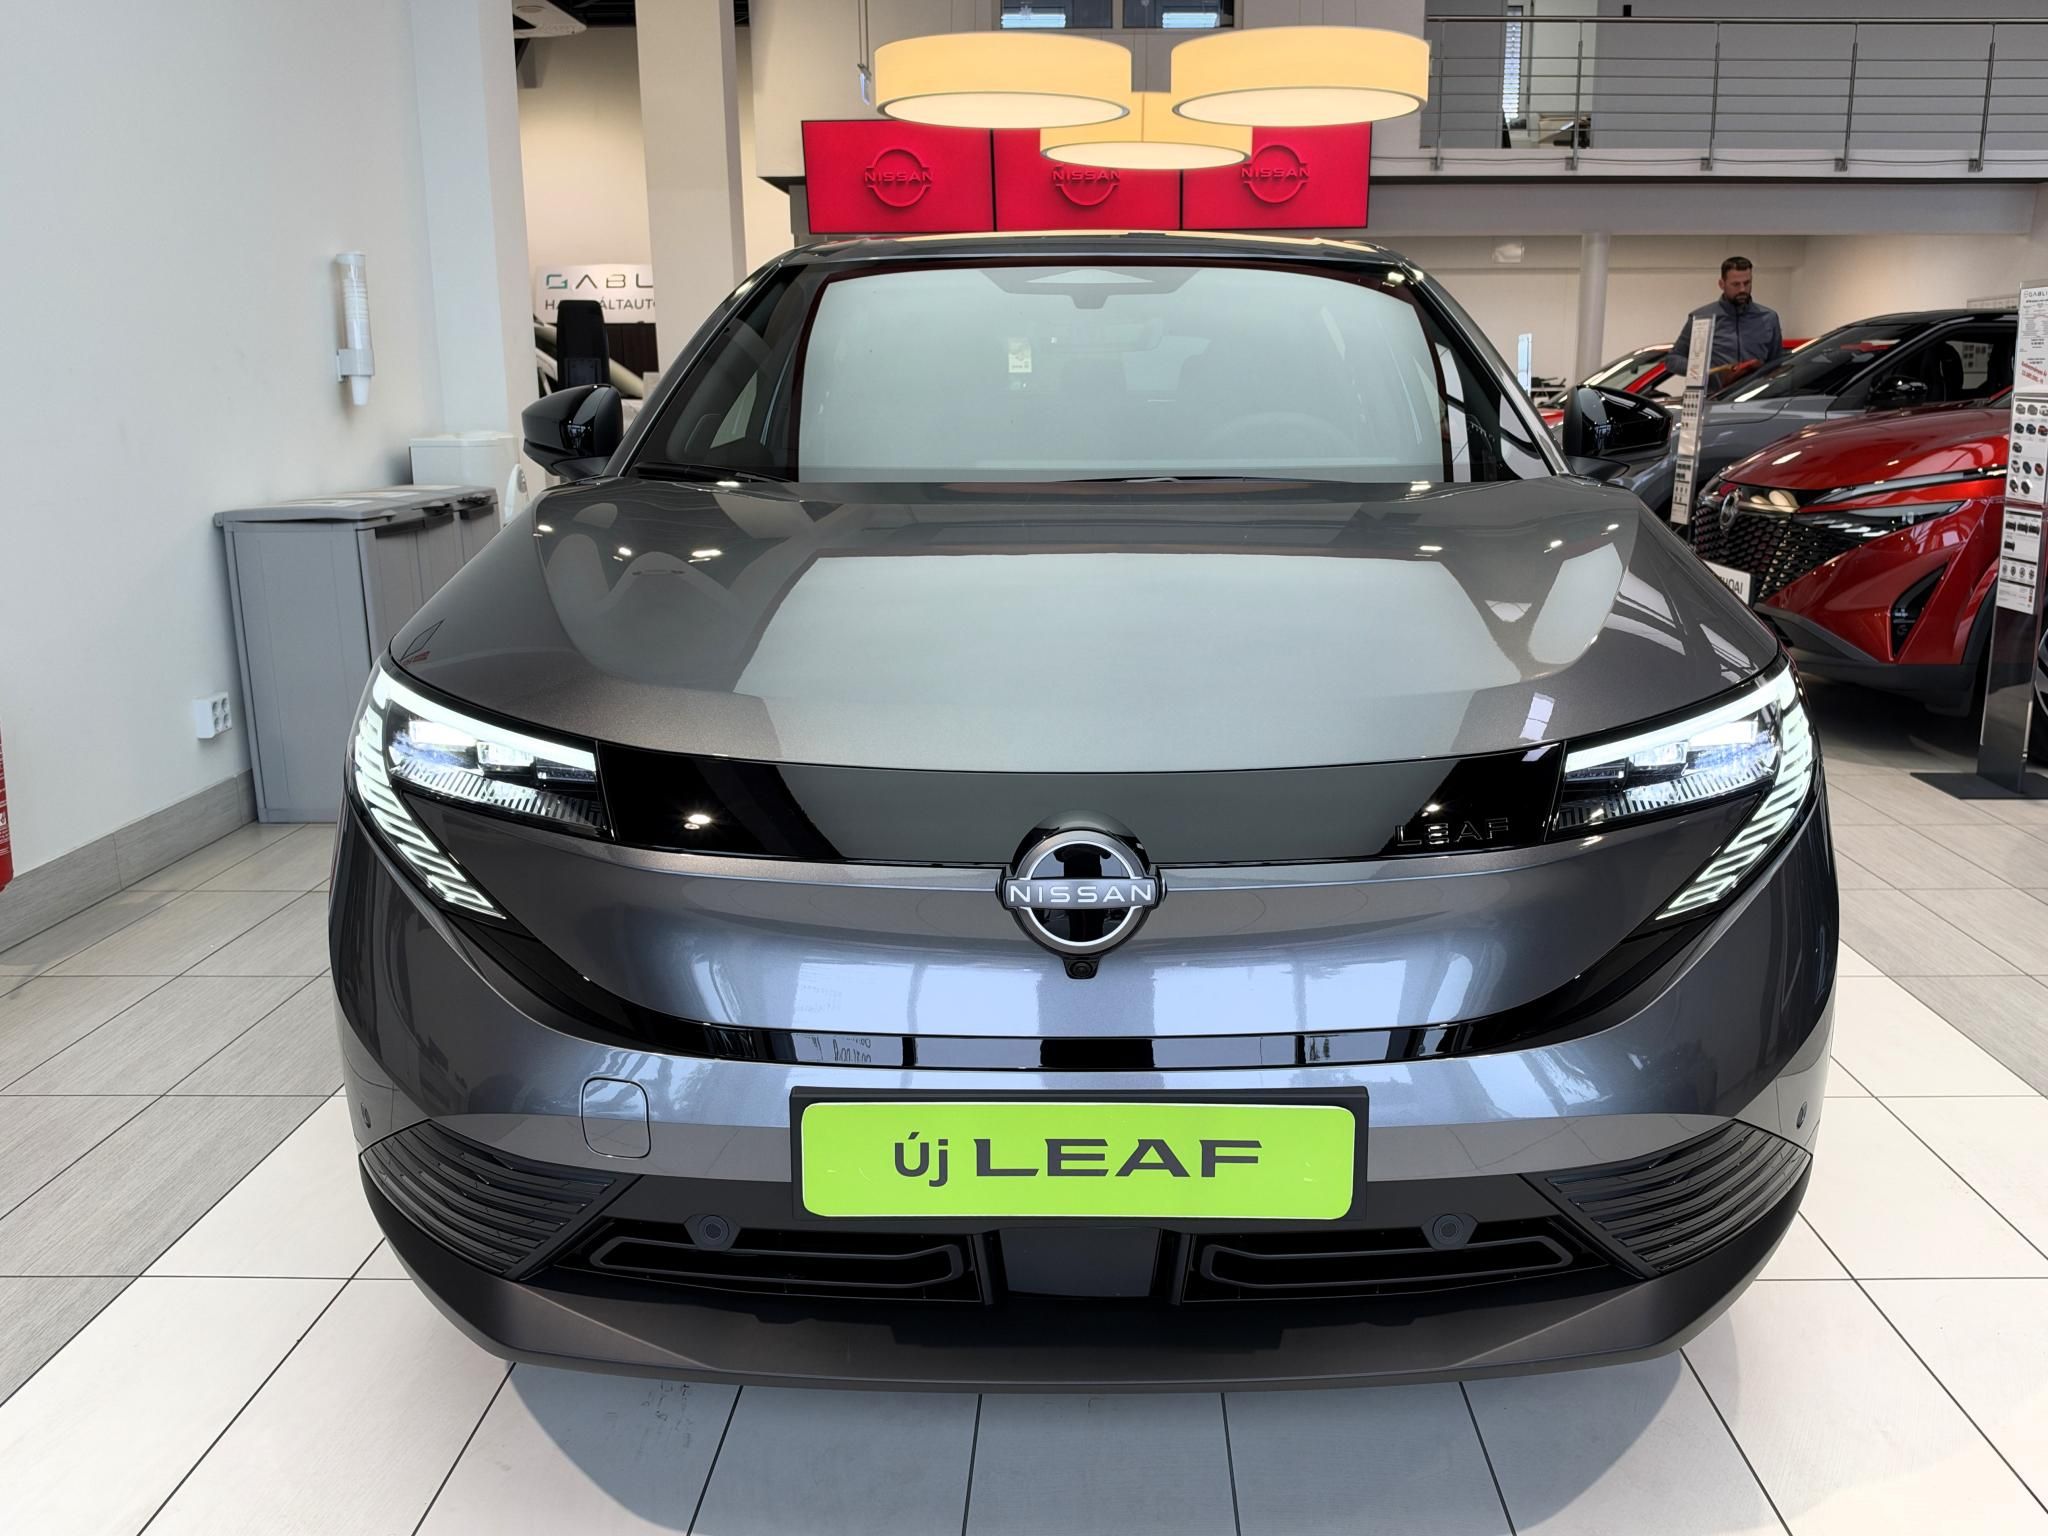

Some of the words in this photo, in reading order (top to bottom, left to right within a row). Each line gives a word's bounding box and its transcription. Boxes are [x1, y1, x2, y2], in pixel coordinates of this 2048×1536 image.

[864, 171, 934, 183] NISSAN
[1052, 170, 1120, 181] NISSAN
[1241, 167, 1313, 178] NISSAN
[1395, 817, 1509, 847] LEAF
[1010, 885, 1152, 903] NISSAN
[894, 1132, 949, 1187] Új
[973, 1139, 1263, 1178] LEAF
